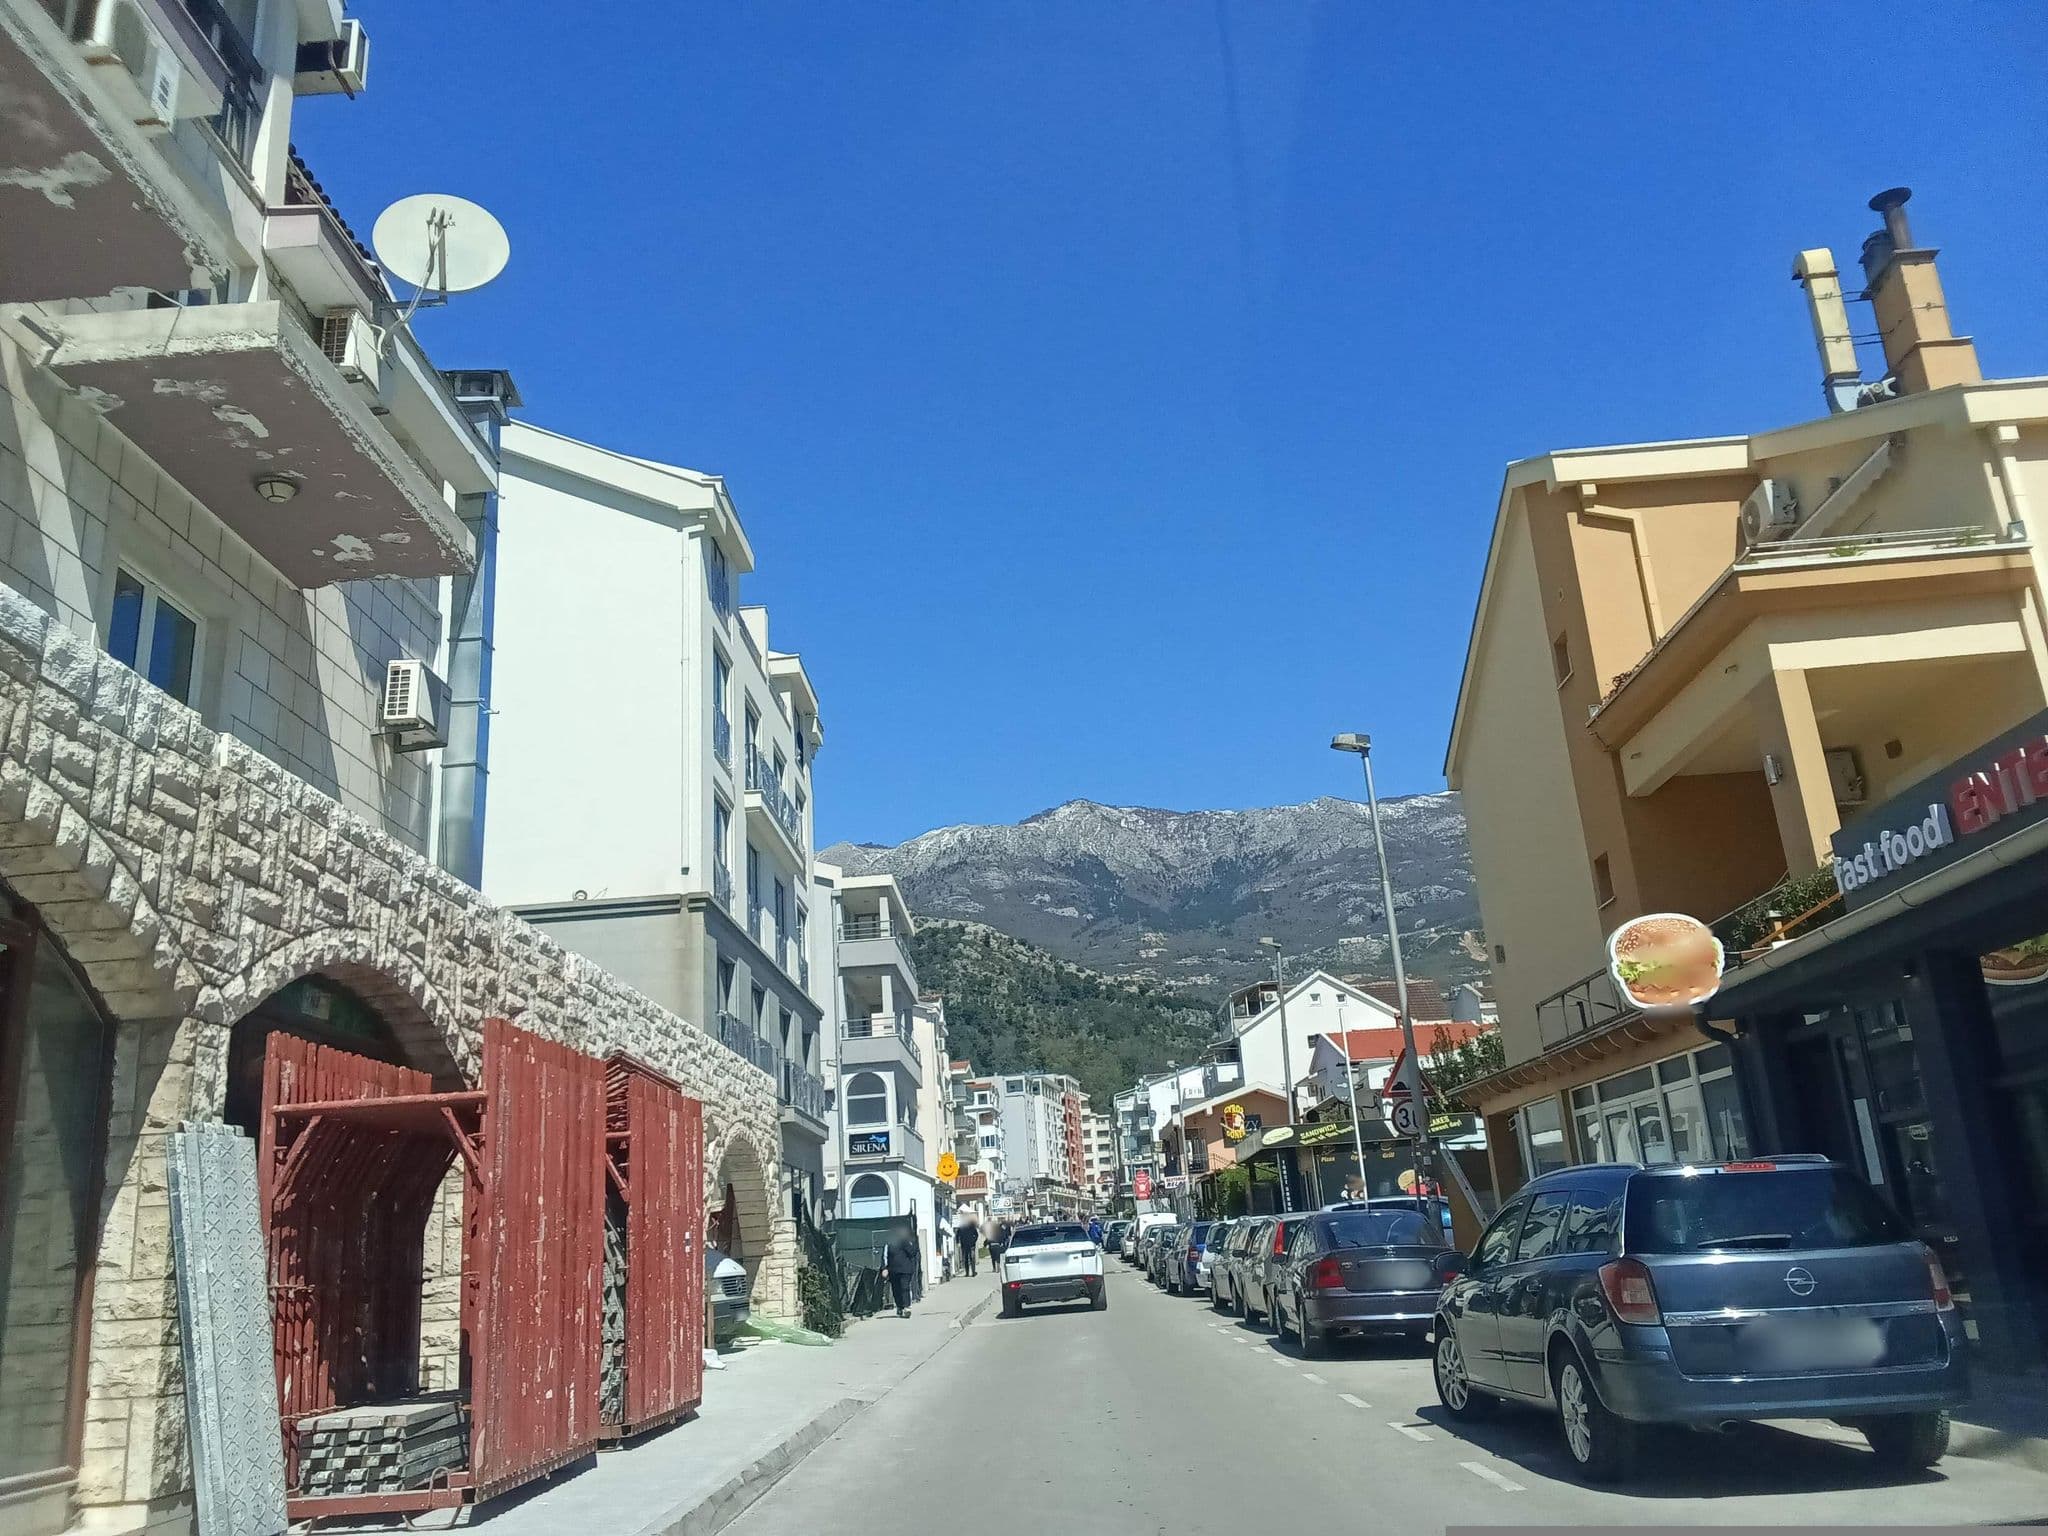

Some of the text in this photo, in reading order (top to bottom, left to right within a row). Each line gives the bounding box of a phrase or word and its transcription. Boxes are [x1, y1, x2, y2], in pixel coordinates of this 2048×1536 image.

[1833, 843, 1884, 895] fast
[1880, 803, 1953, 872] food
[1300, 1123, 1337, 1140] SANDWICH
[851, 1143, 887, 1153] SIRENA
